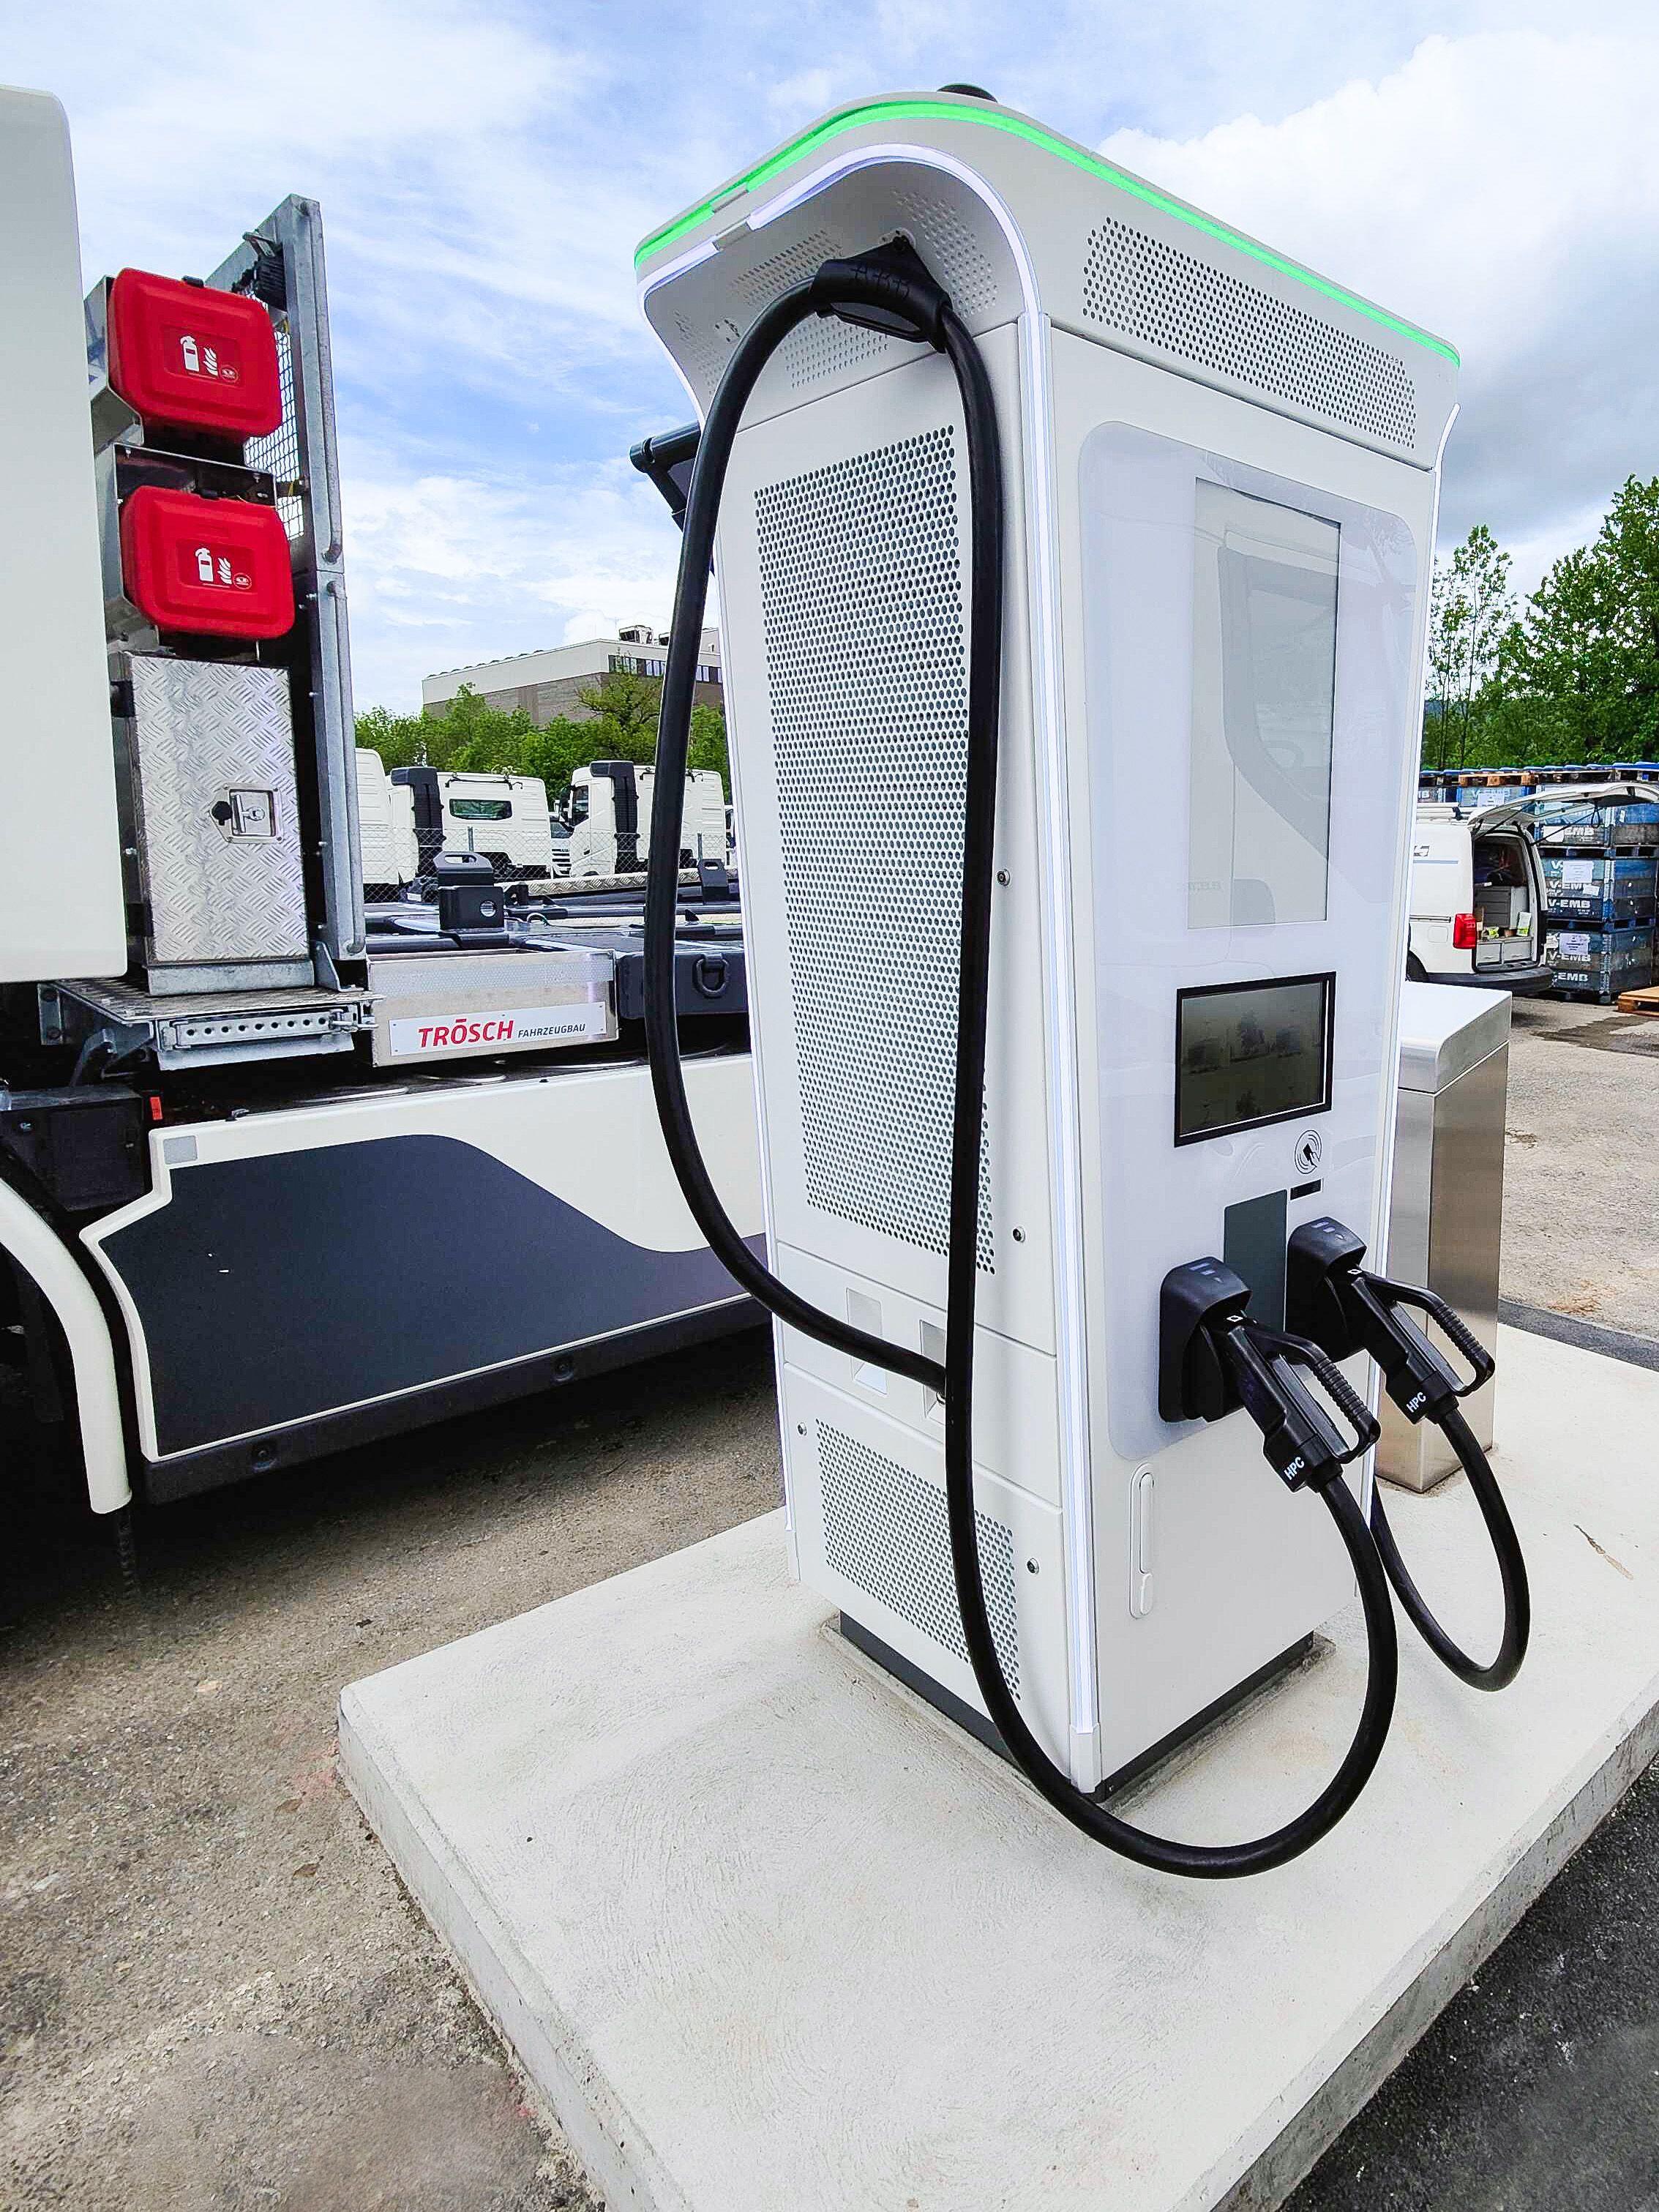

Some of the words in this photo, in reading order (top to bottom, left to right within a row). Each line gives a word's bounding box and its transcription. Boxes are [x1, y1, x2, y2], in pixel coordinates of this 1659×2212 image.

[1548, 898, 1591, 908] V-EMB
[517, 1023, 586, 1039] FAHRZEUGBAU
[1406, 1391, 1426, 1413] HPC
[1284, 1457, 1305, 1480] HPC
